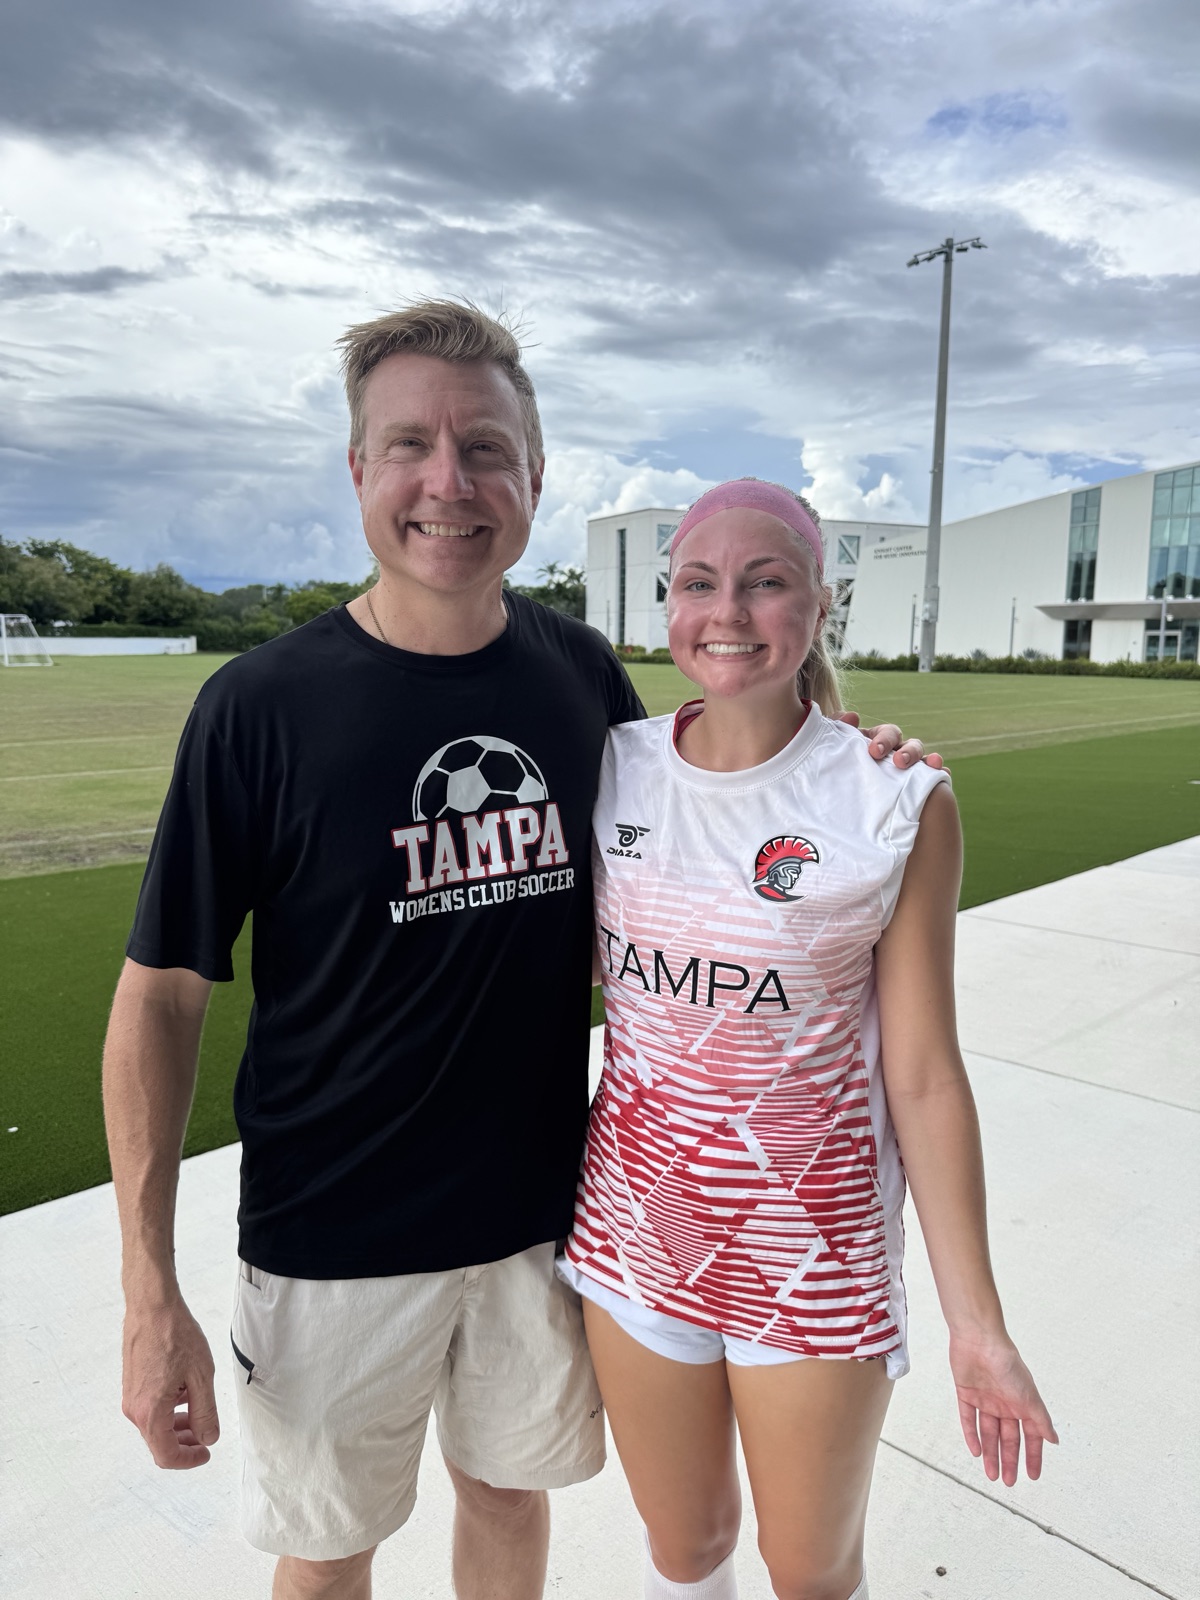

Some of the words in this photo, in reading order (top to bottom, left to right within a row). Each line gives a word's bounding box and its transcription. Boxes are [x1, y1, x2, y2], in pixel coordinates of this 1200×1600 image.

[391, 802, 569, 894] TAMPA
[606, 847, 642, 859] DIAZA
[389, 888, 465, 923] WOMENS
[468, 880, 517, 907] CLUB
[518, 868, 575, 898] SOCCER
[600, 925, 791, 1013] TAMPA
